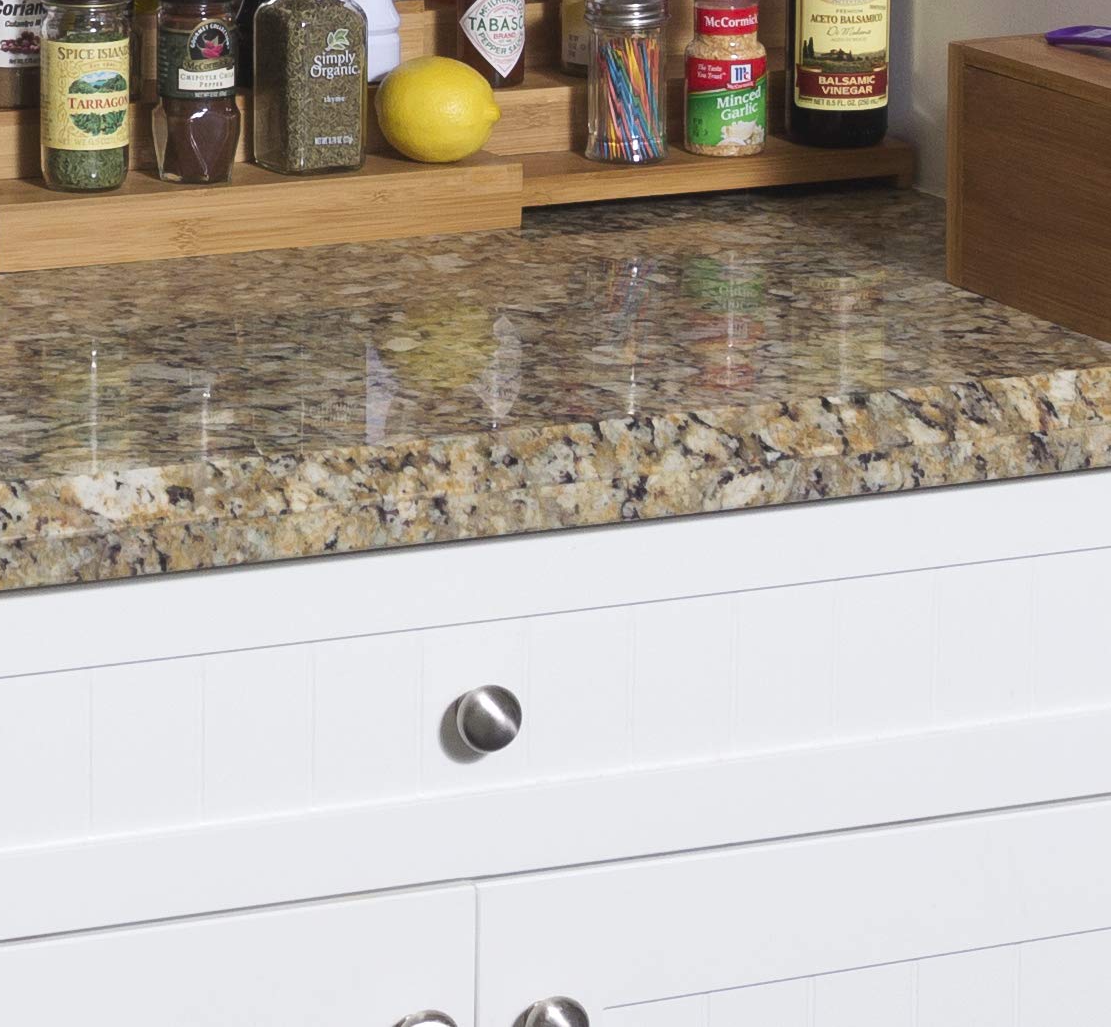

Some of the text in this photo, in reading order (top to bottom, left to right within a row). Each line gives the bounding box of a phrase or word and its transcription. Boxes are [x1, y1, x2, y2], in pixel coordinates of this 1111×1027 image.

[469, 16, 523, 32] TABASC
[810, 13, 884, 25] ACETO BALSAMICO
[478, 33, 507, 55] PEPPER
[58, 46, 95, 60] SPICE
[314, 50, 355, 67] Simply
[310, 65, 359, 79] Organic
[818, 75, 876, 86] BALSAMIC
[821, 85, 873, 95] VINEGAR
[323, 95, 345, 104] thyme
[716, 85, 761, 110] Minced
[813, 98, 825, 106] NET
[721, 102, 758, 121] Garlic
